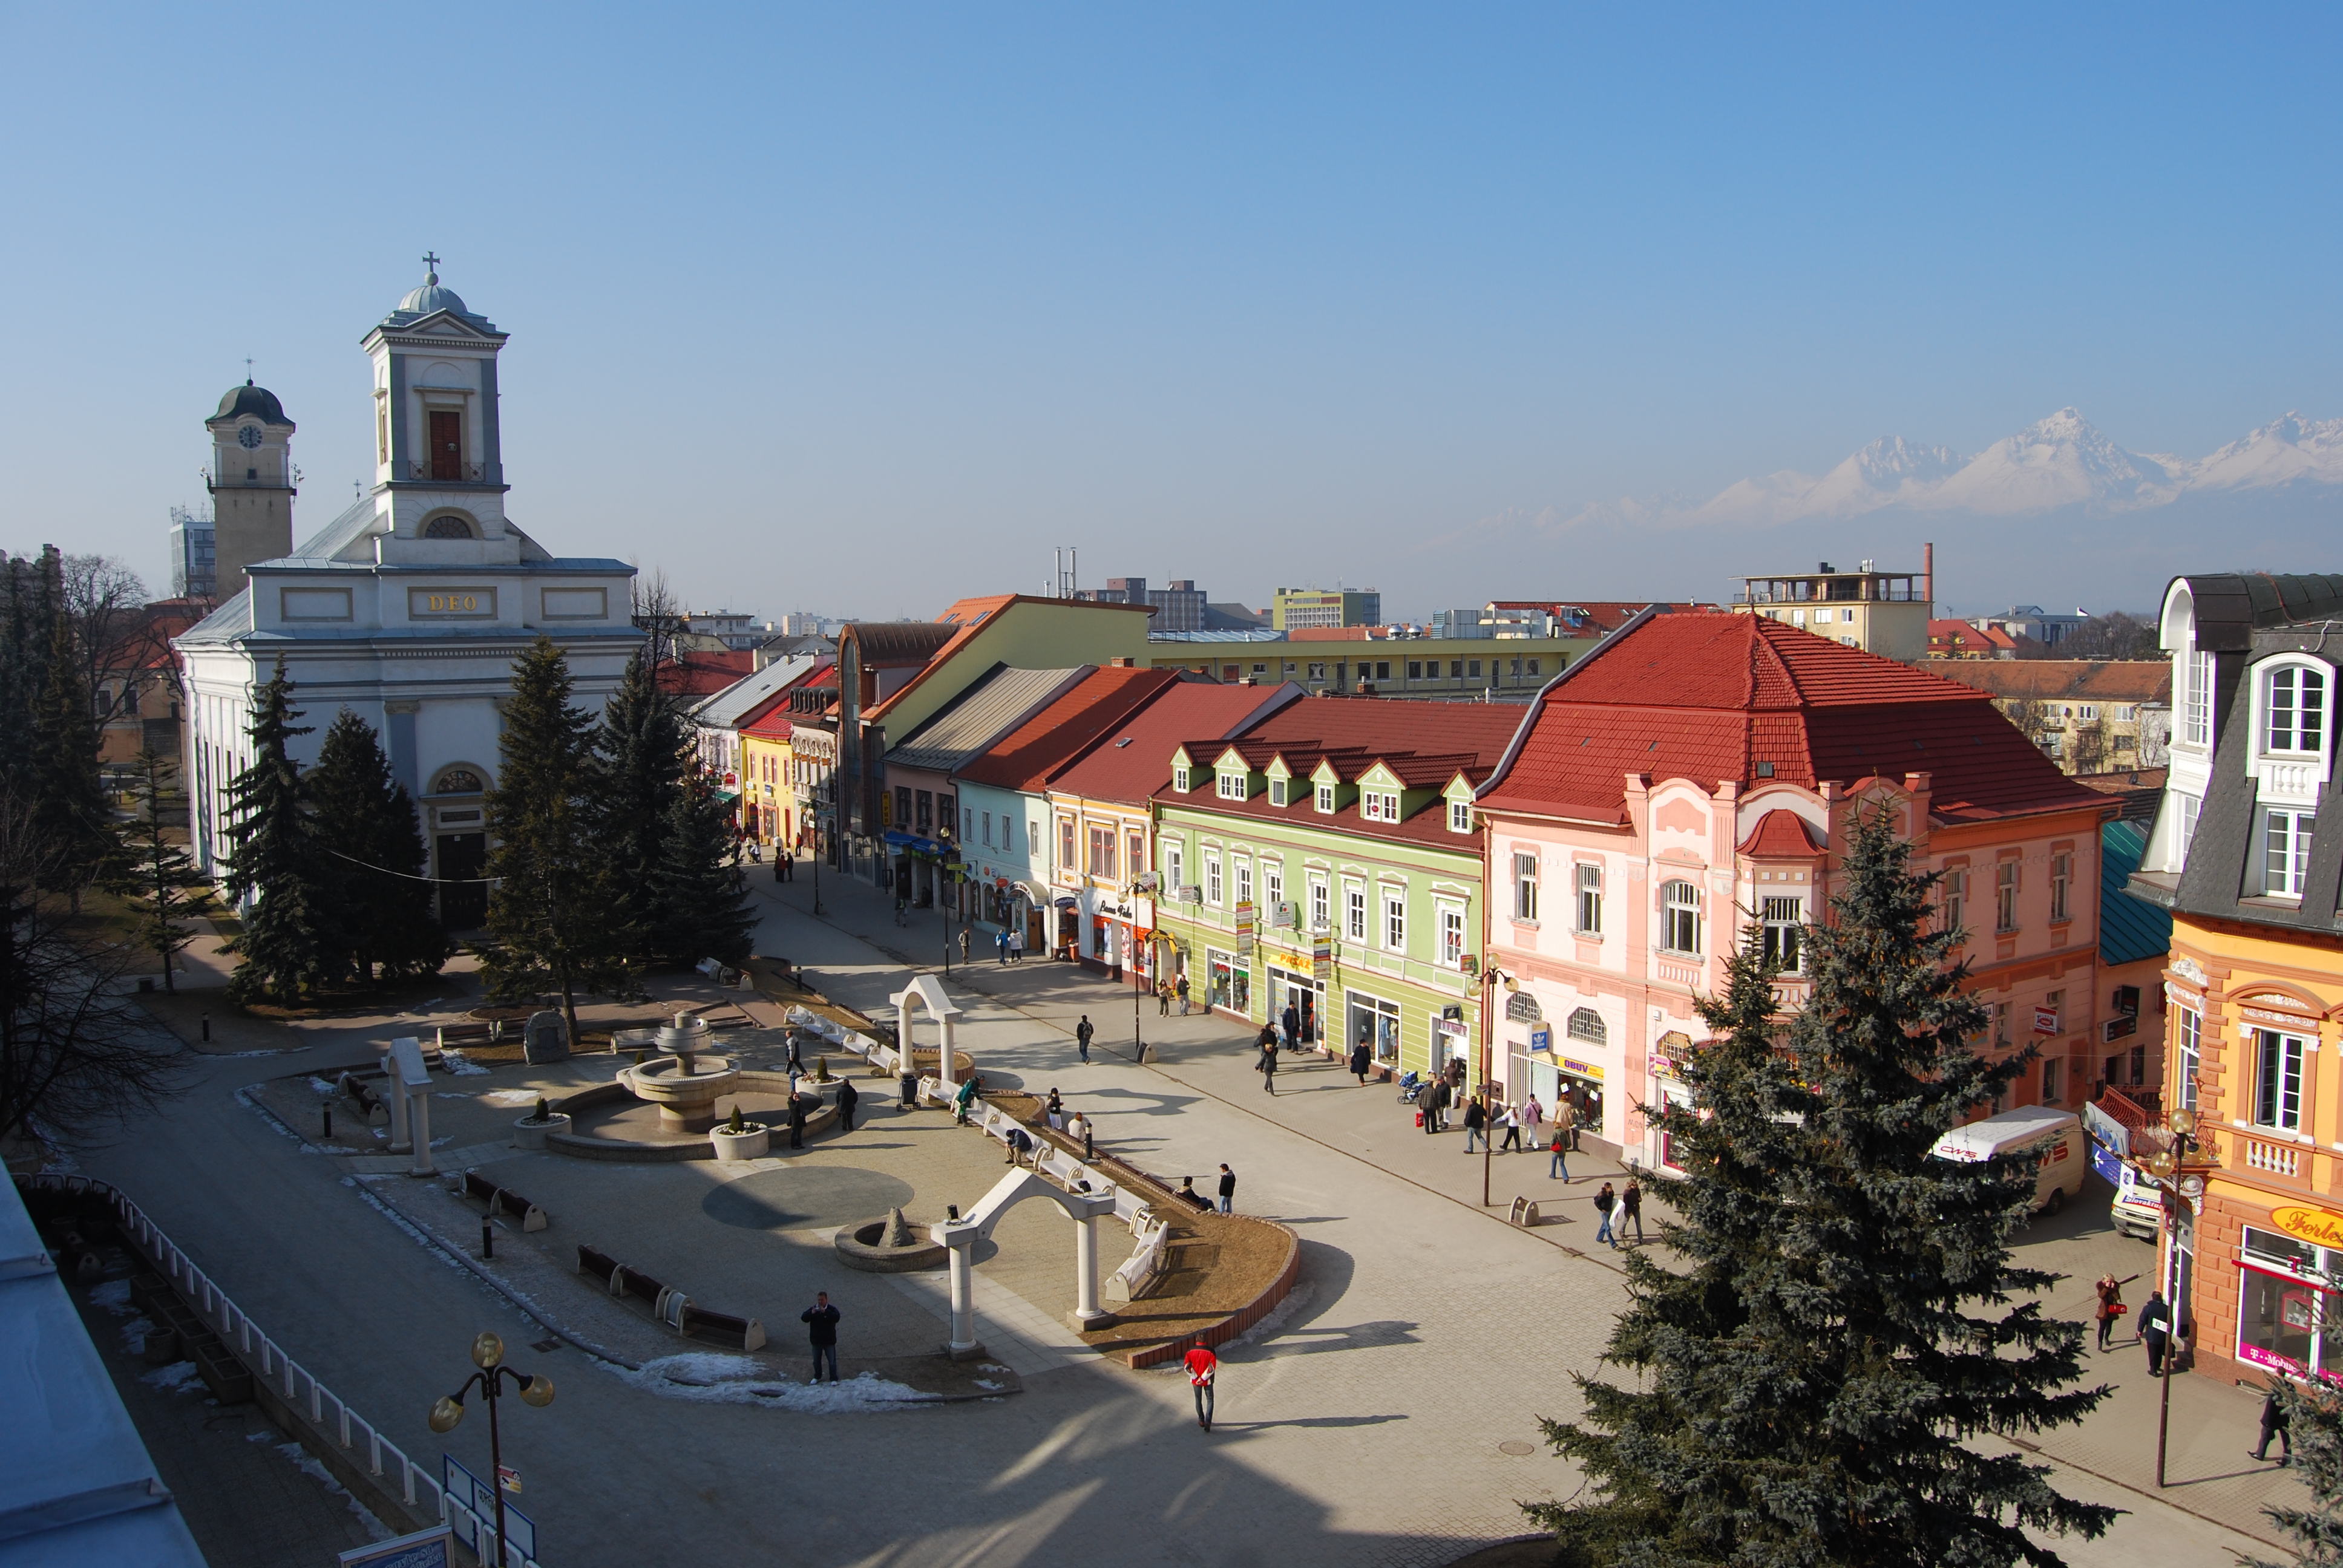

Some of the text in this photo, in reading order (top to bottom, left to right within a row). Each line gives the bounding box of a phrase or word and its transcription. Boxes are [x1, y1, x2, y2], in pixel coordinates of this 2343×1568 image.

[428, 596, 477, 611] DEO
[1564, 1059, 1588, 1073] OBUV
[1941, 1146, 1978, 1158] CWS
[2286, 1210, 2343, 1244] Forte
